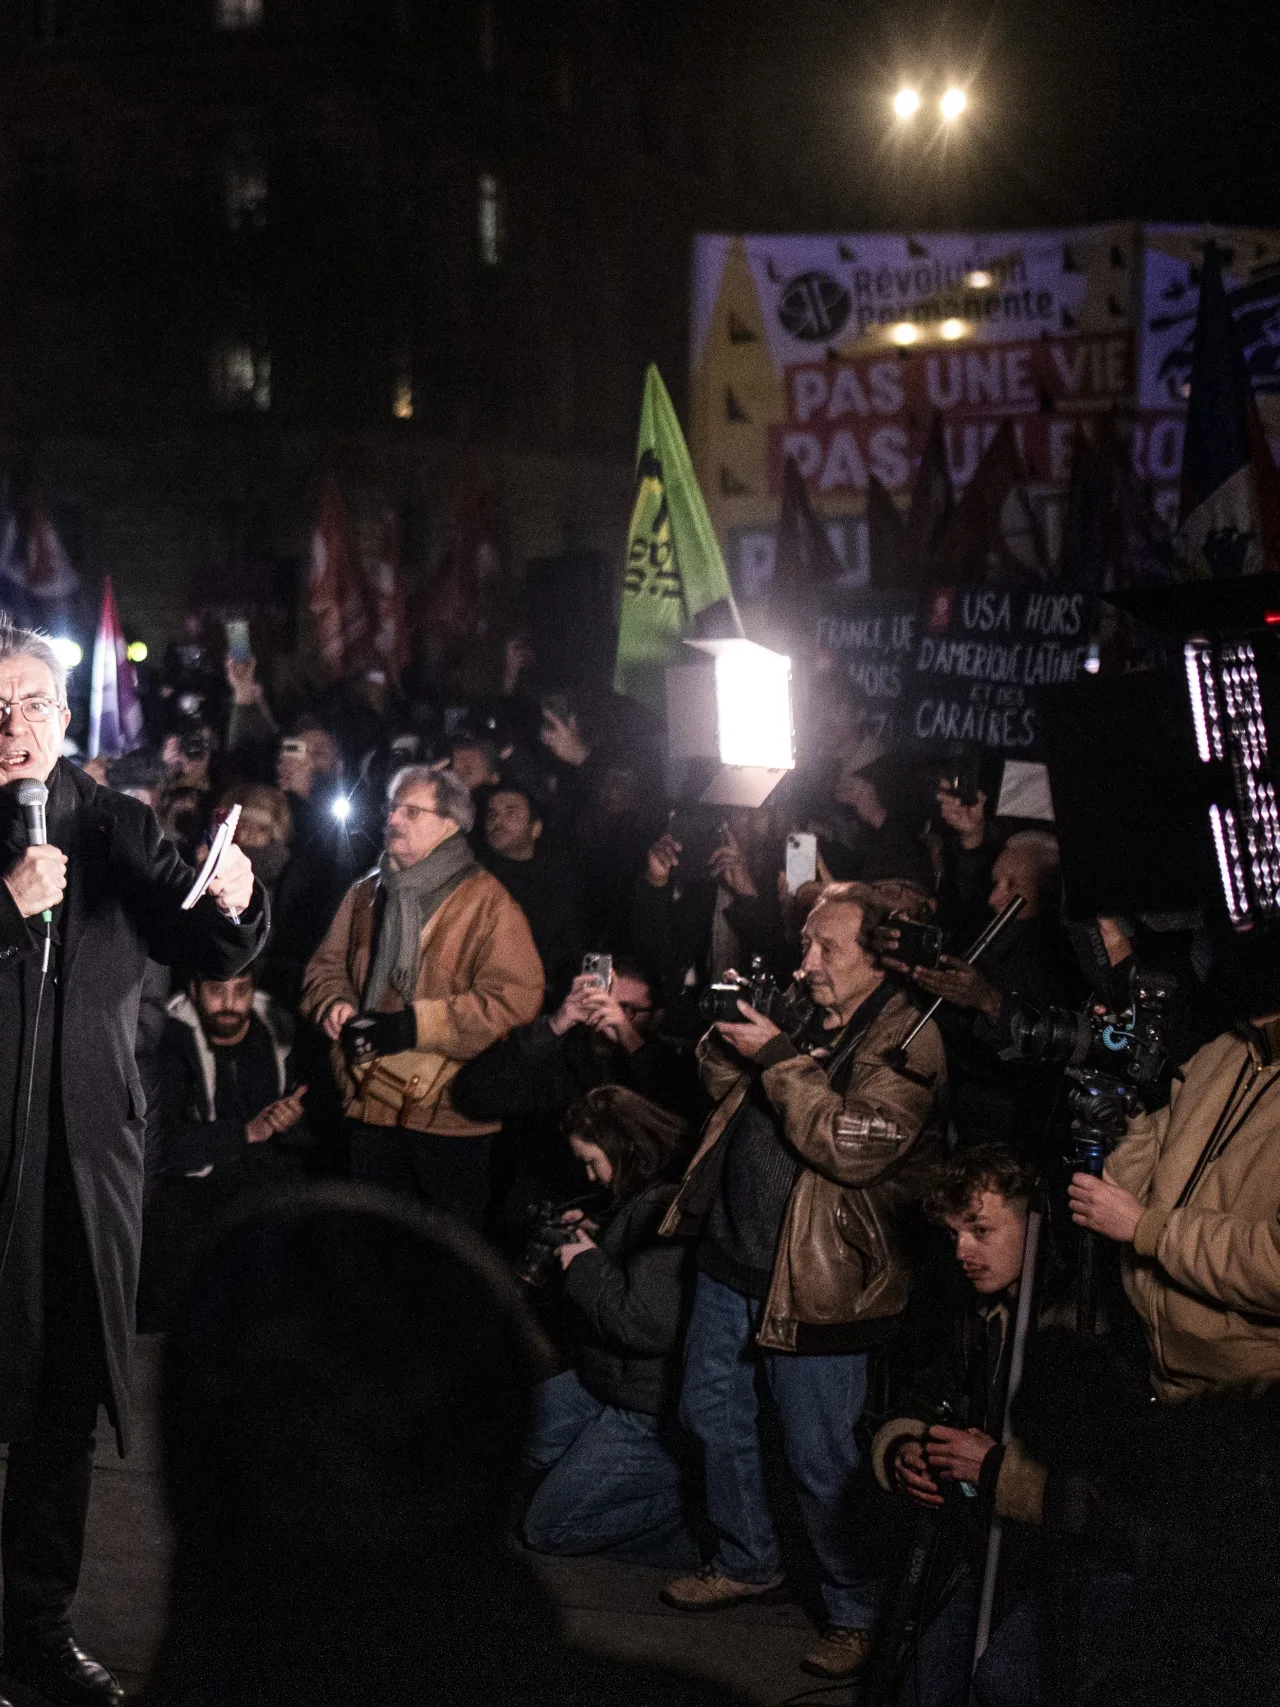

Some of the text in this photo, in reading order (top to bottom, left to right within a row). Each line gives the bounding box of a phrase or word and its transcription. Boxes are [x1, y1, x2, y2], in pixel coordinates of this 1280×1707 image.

[793, 340, 1128, 421] PAS UNE VIE
[782, 425, 910, 490] PAS
[962, 591, 1083, 636] USA HORS
